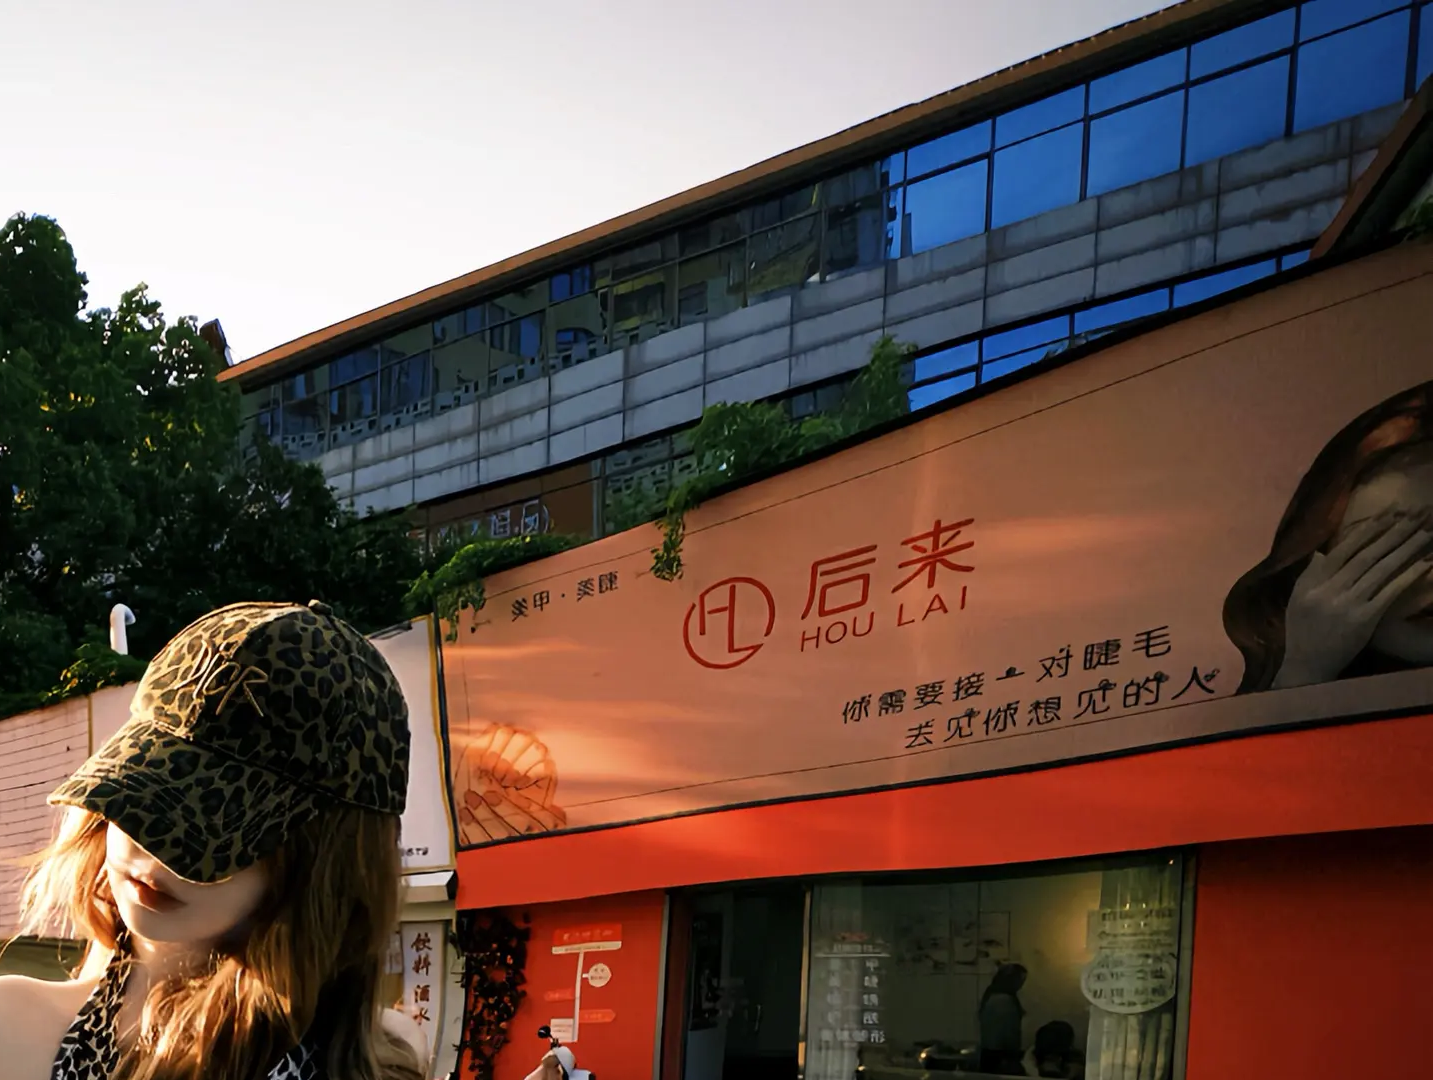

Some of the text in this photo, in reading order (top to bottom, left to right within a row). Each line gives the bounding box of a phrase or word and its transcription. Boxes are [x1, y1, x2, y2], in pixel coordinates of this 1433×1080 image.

[800, 518, 976, 620] 后来
[799, 585, 968, 653] HOU LAI
[842, 625, 1172, 724] 你需要接一对睫毛
[903, 666, 1221, 749] 去见你想见的人
